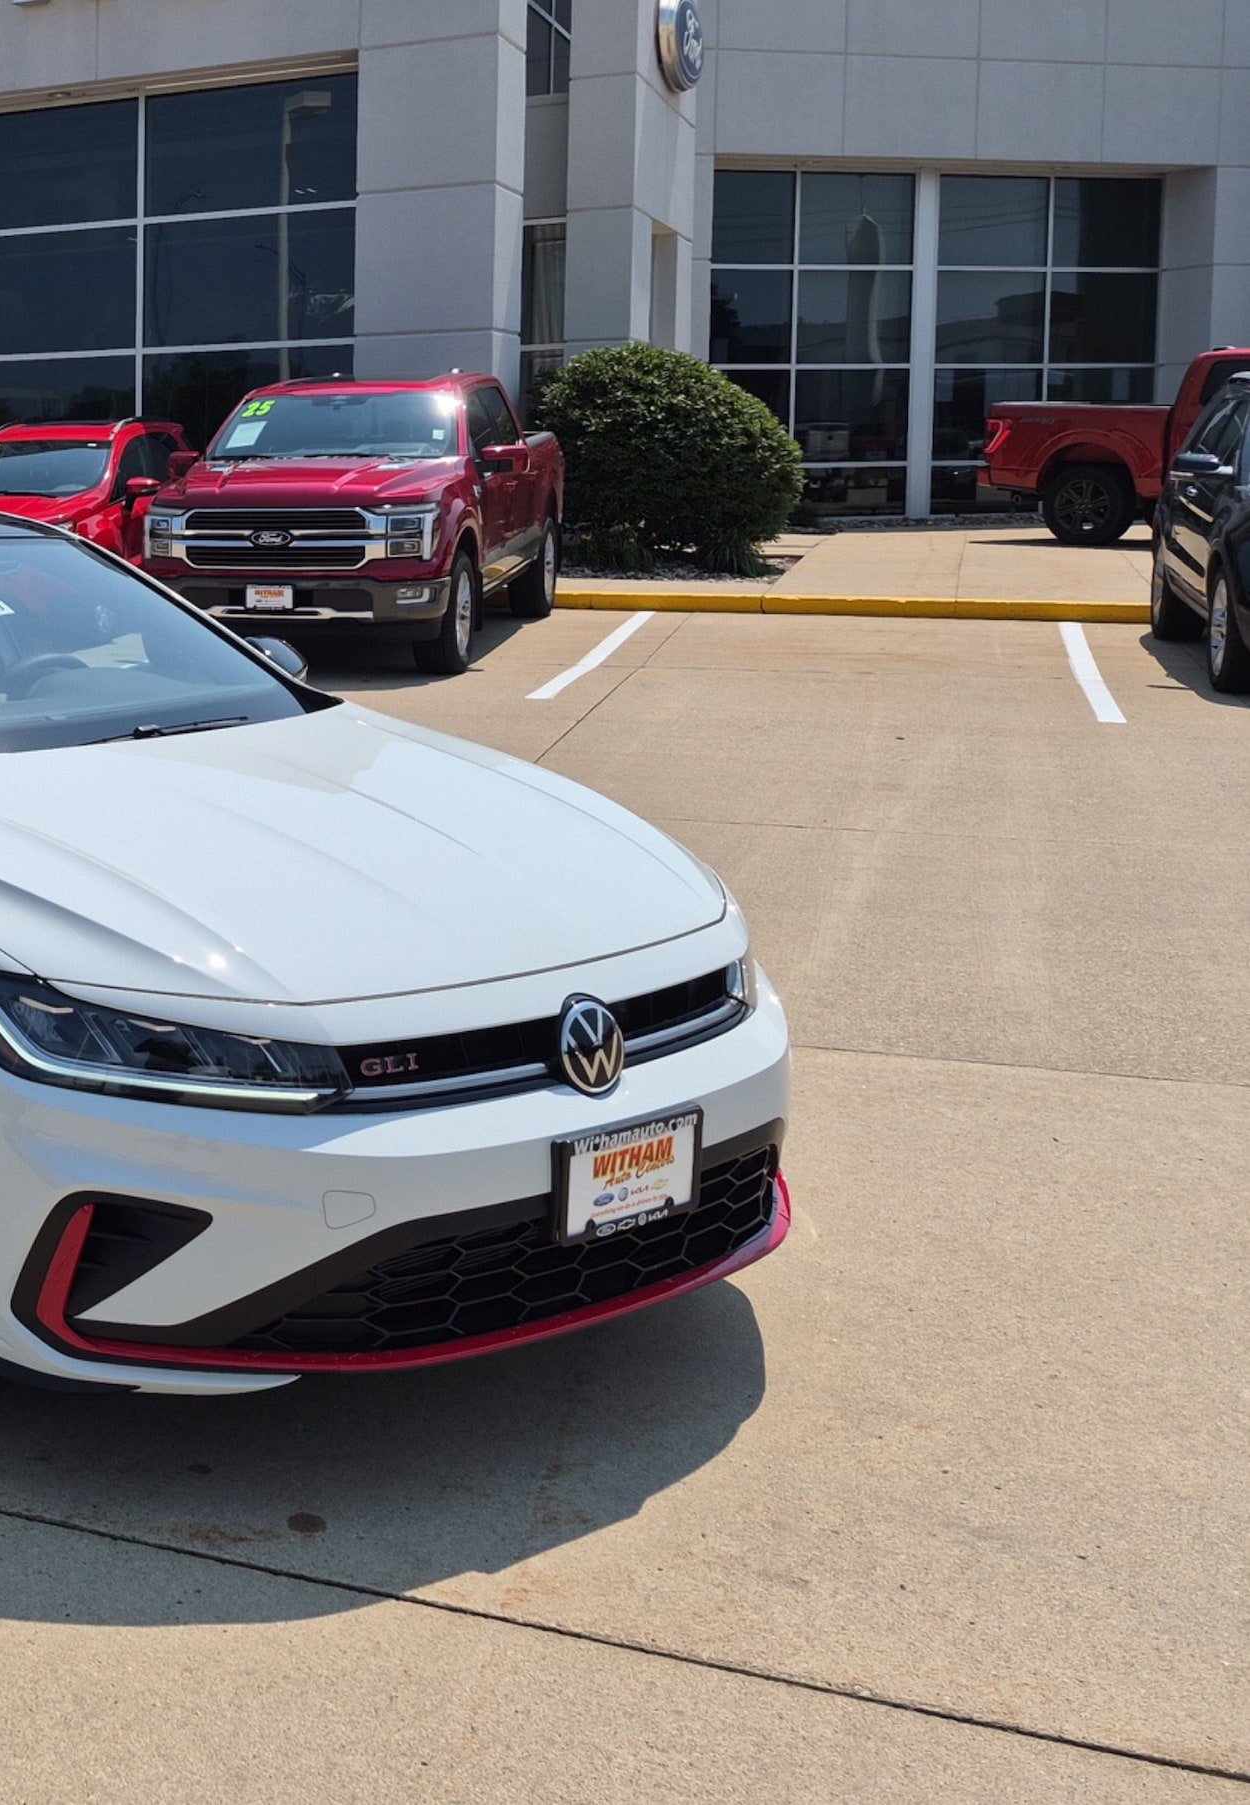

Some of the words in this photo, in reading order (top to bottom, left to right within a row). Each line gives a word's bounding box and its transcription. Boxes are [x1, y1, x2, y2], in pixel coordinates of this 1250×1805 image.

[242, 400, 276, 417] 25
[359, 1052, 420, 1077] GLI
[593, 1135, 675, 1180] WITHAM
